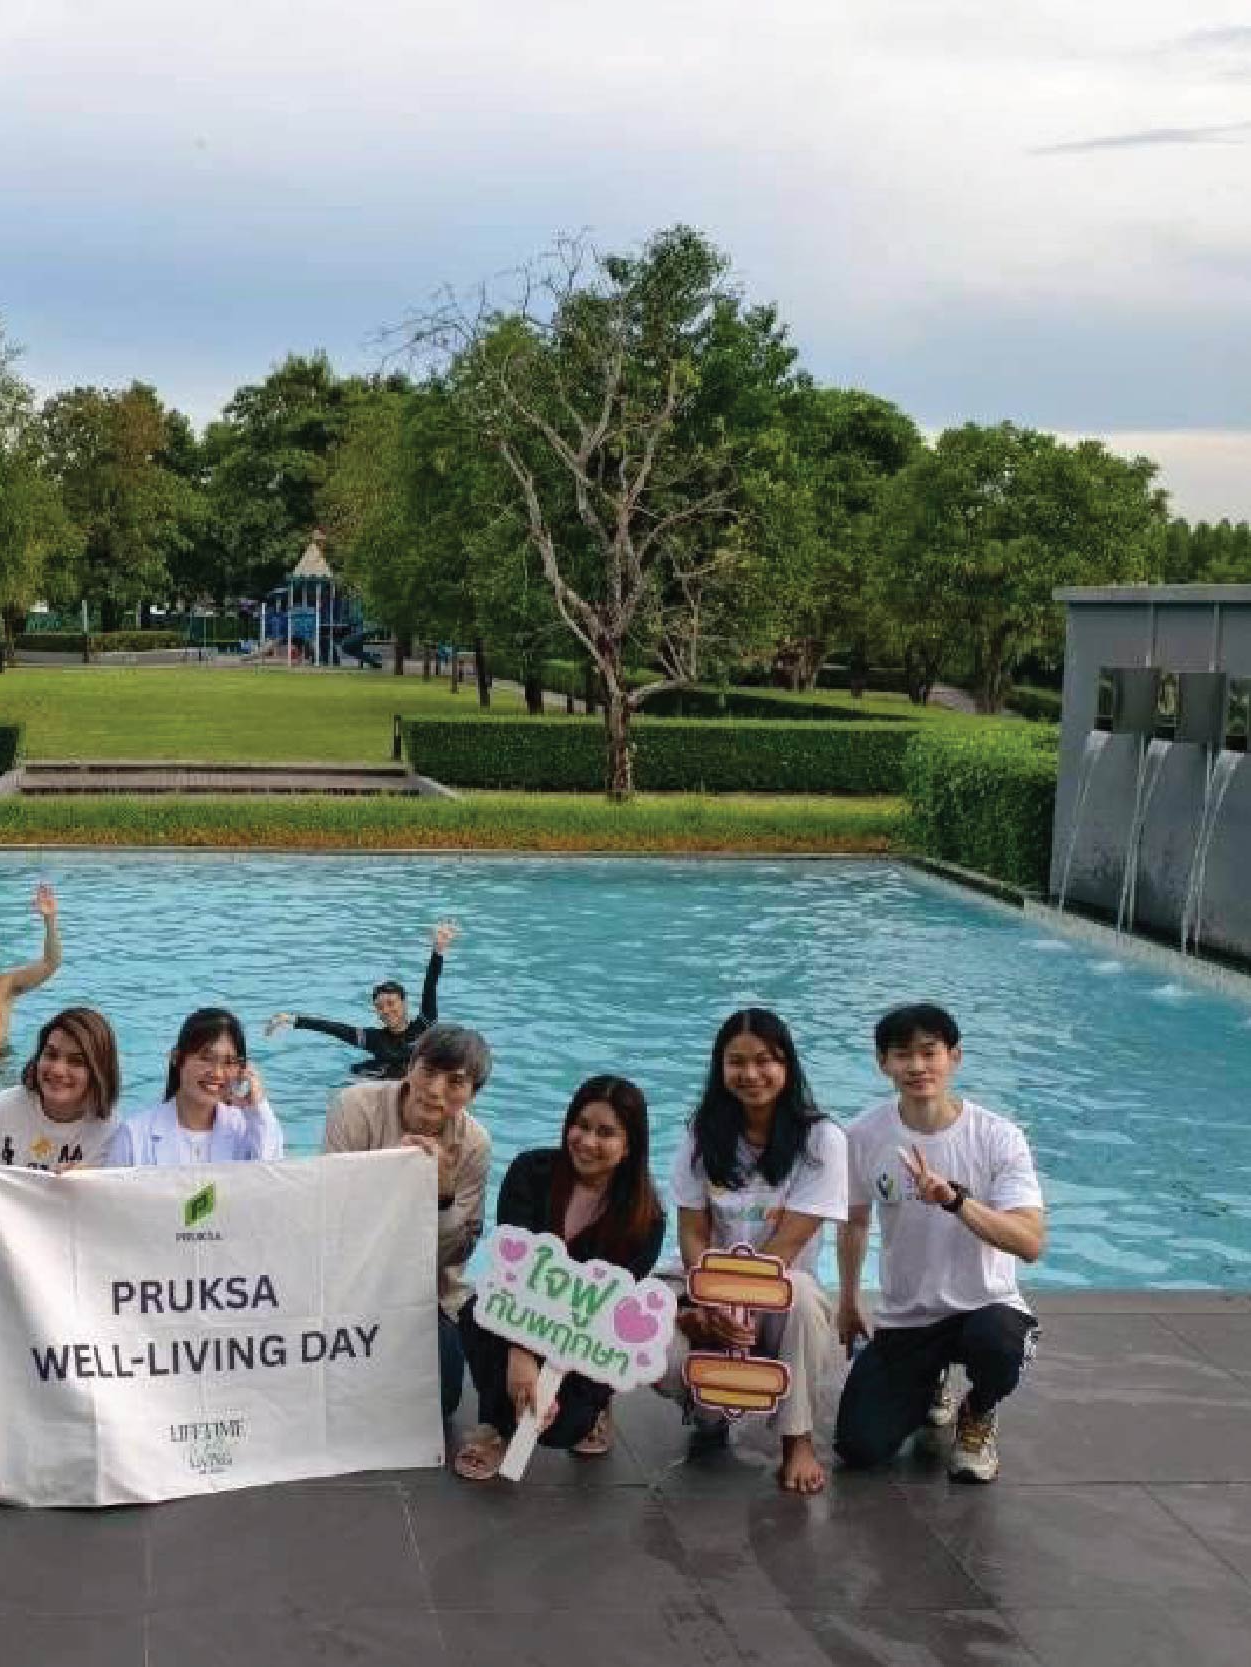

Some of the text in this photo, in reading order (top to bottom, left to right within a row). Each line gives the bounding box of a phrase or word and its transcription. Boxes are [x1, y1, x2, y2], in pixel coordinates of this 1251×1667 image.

[111, 1275, 279, 1315] PRUKSA
[527, 1245, 620, 1328] ใจฟู
[30, 1324, 381, 1381] WELL-LIVING DAY
[484, 1288, 629, 1376] กับพฤกษา
